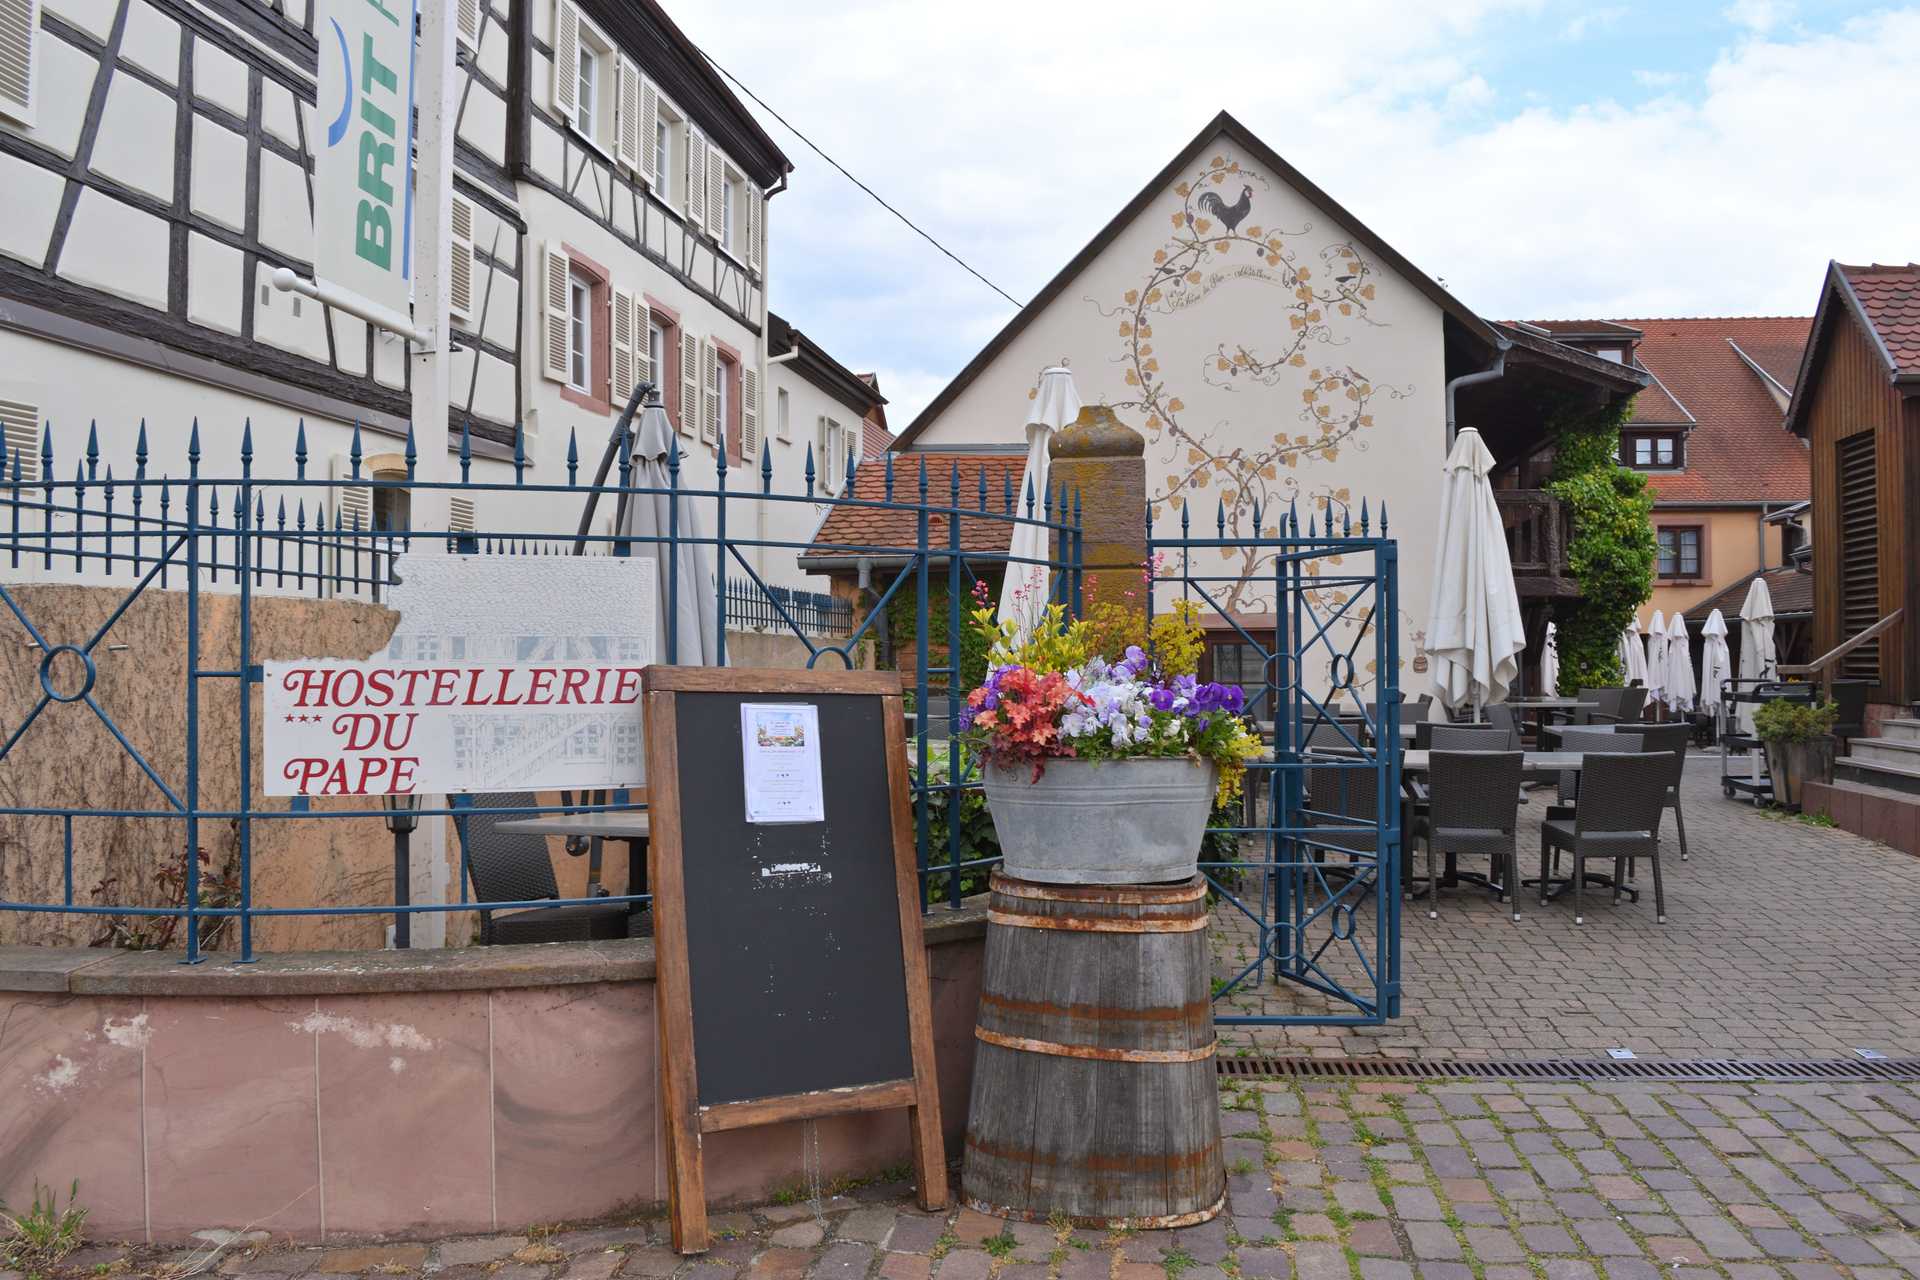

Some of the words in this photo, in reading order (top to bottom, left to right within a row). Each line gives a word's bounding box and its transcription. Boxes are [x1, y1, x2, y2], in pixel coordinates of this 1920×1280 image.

[355, 32, 397, 272] BRIT
[283, 668, 642, 707] HOSTELLERIE
[332, 713, 419, 751] DU
[283, 757, 420, 795] PAPE
